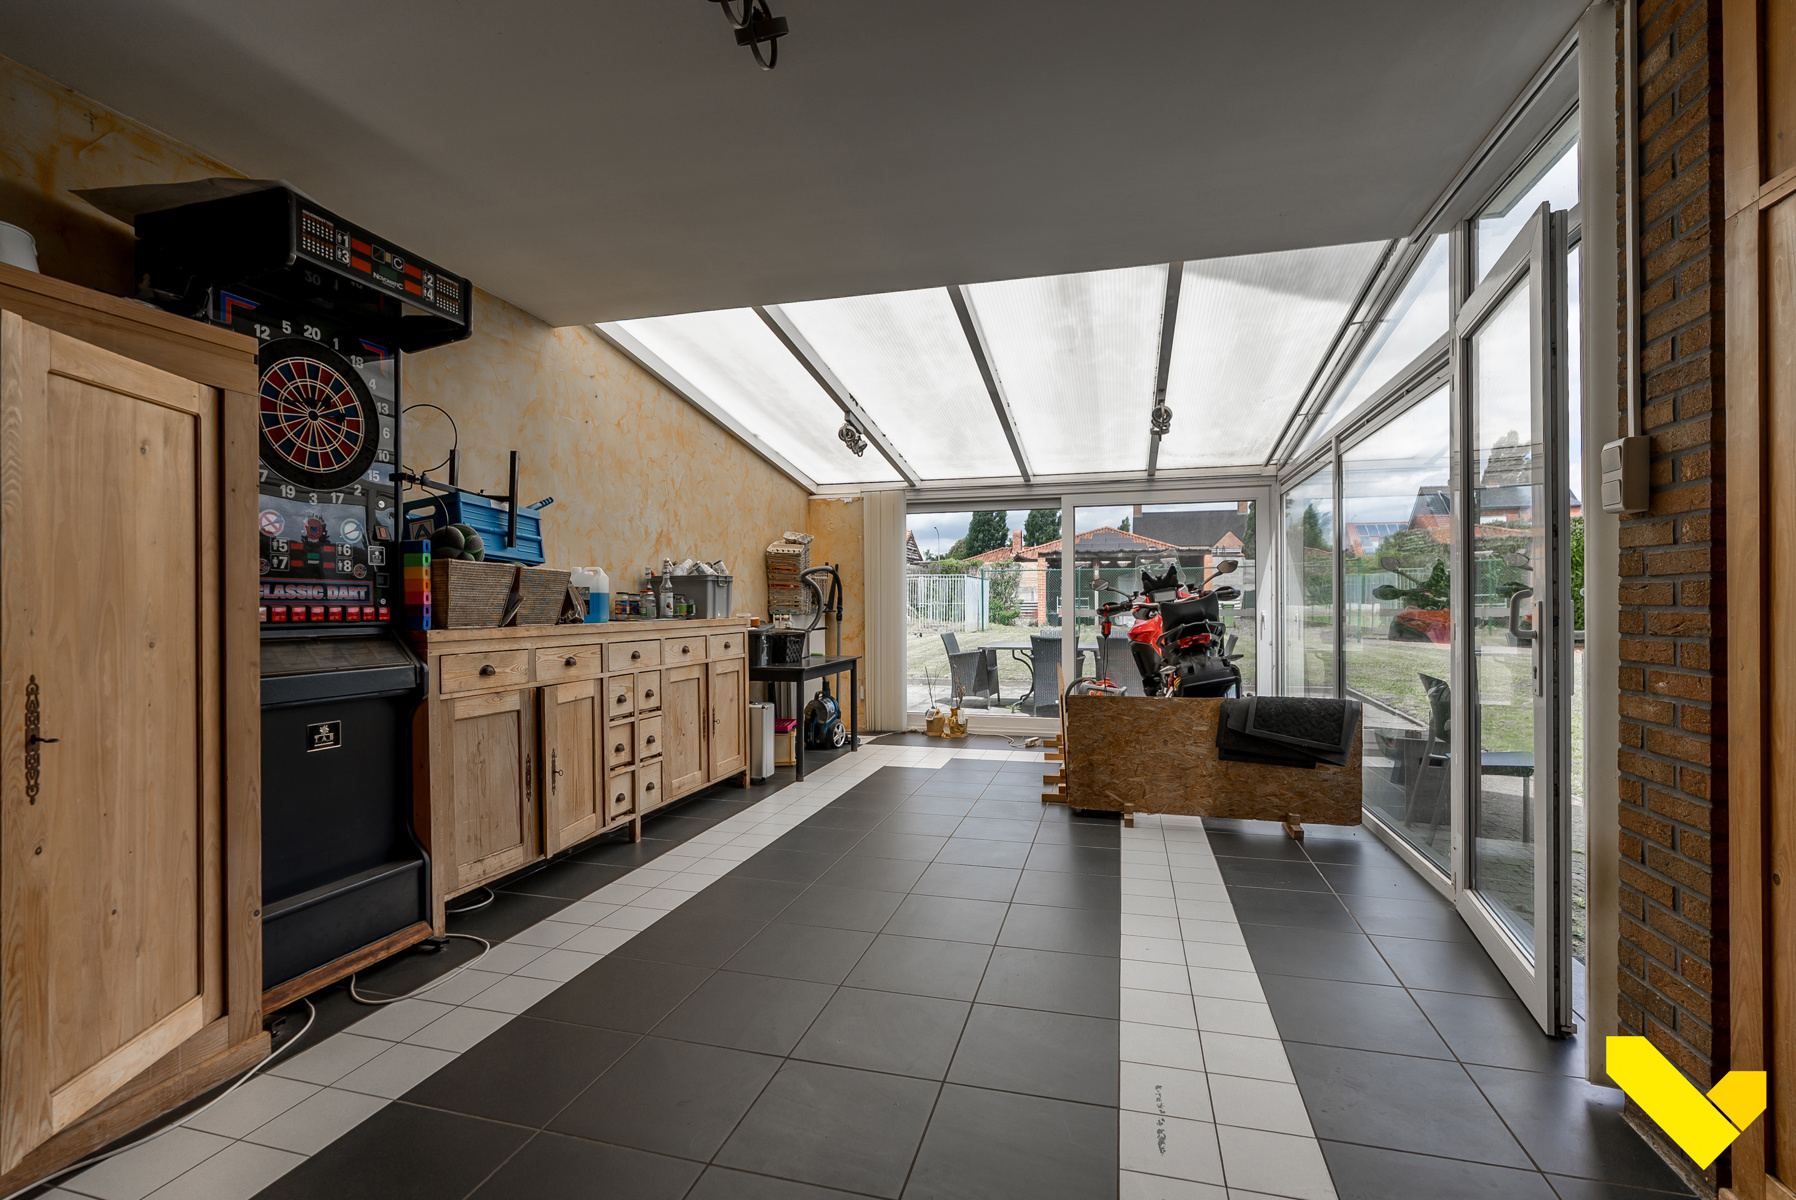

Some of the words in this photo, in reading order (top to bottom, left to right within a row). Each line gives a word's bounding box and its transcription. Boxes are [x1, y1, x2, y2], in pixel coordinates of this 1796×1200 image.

[344, 234, 349, 248] 1
[342, 250, 350, 264] 3
[393, 258, 403, 270] C
[428, 274, 434, 286] 2
[427, 288, 434, 301] 4
[254, 324, 271, 340] 12
[282, 320, 292, 334] 5
[304, 324, 321, 341] 20
[333, 338, 339, 350] 1
[350, 355, 364, 369] 18
[369, 378, 376, 390] 4
[376, 402, 389, 415] 13
[382, 428, 390, 439] 6
[378, 450, 389, 462] 10
[260, 470, 268, 482] 7
[368, 470, 380, 482] 15
[280, 485, 296, 498] 19
[354, 484, 362, 496] 2
[309, 493, 318, 505] 3
[330, 492, 344, 504] 17
[278, 540, 288, 552] 5
[343, 544, 351, 556] 6
[278, 557, 288, 569] 7
[343, 560, 352, 572] 8
[326, 586, 367, 600] DART
